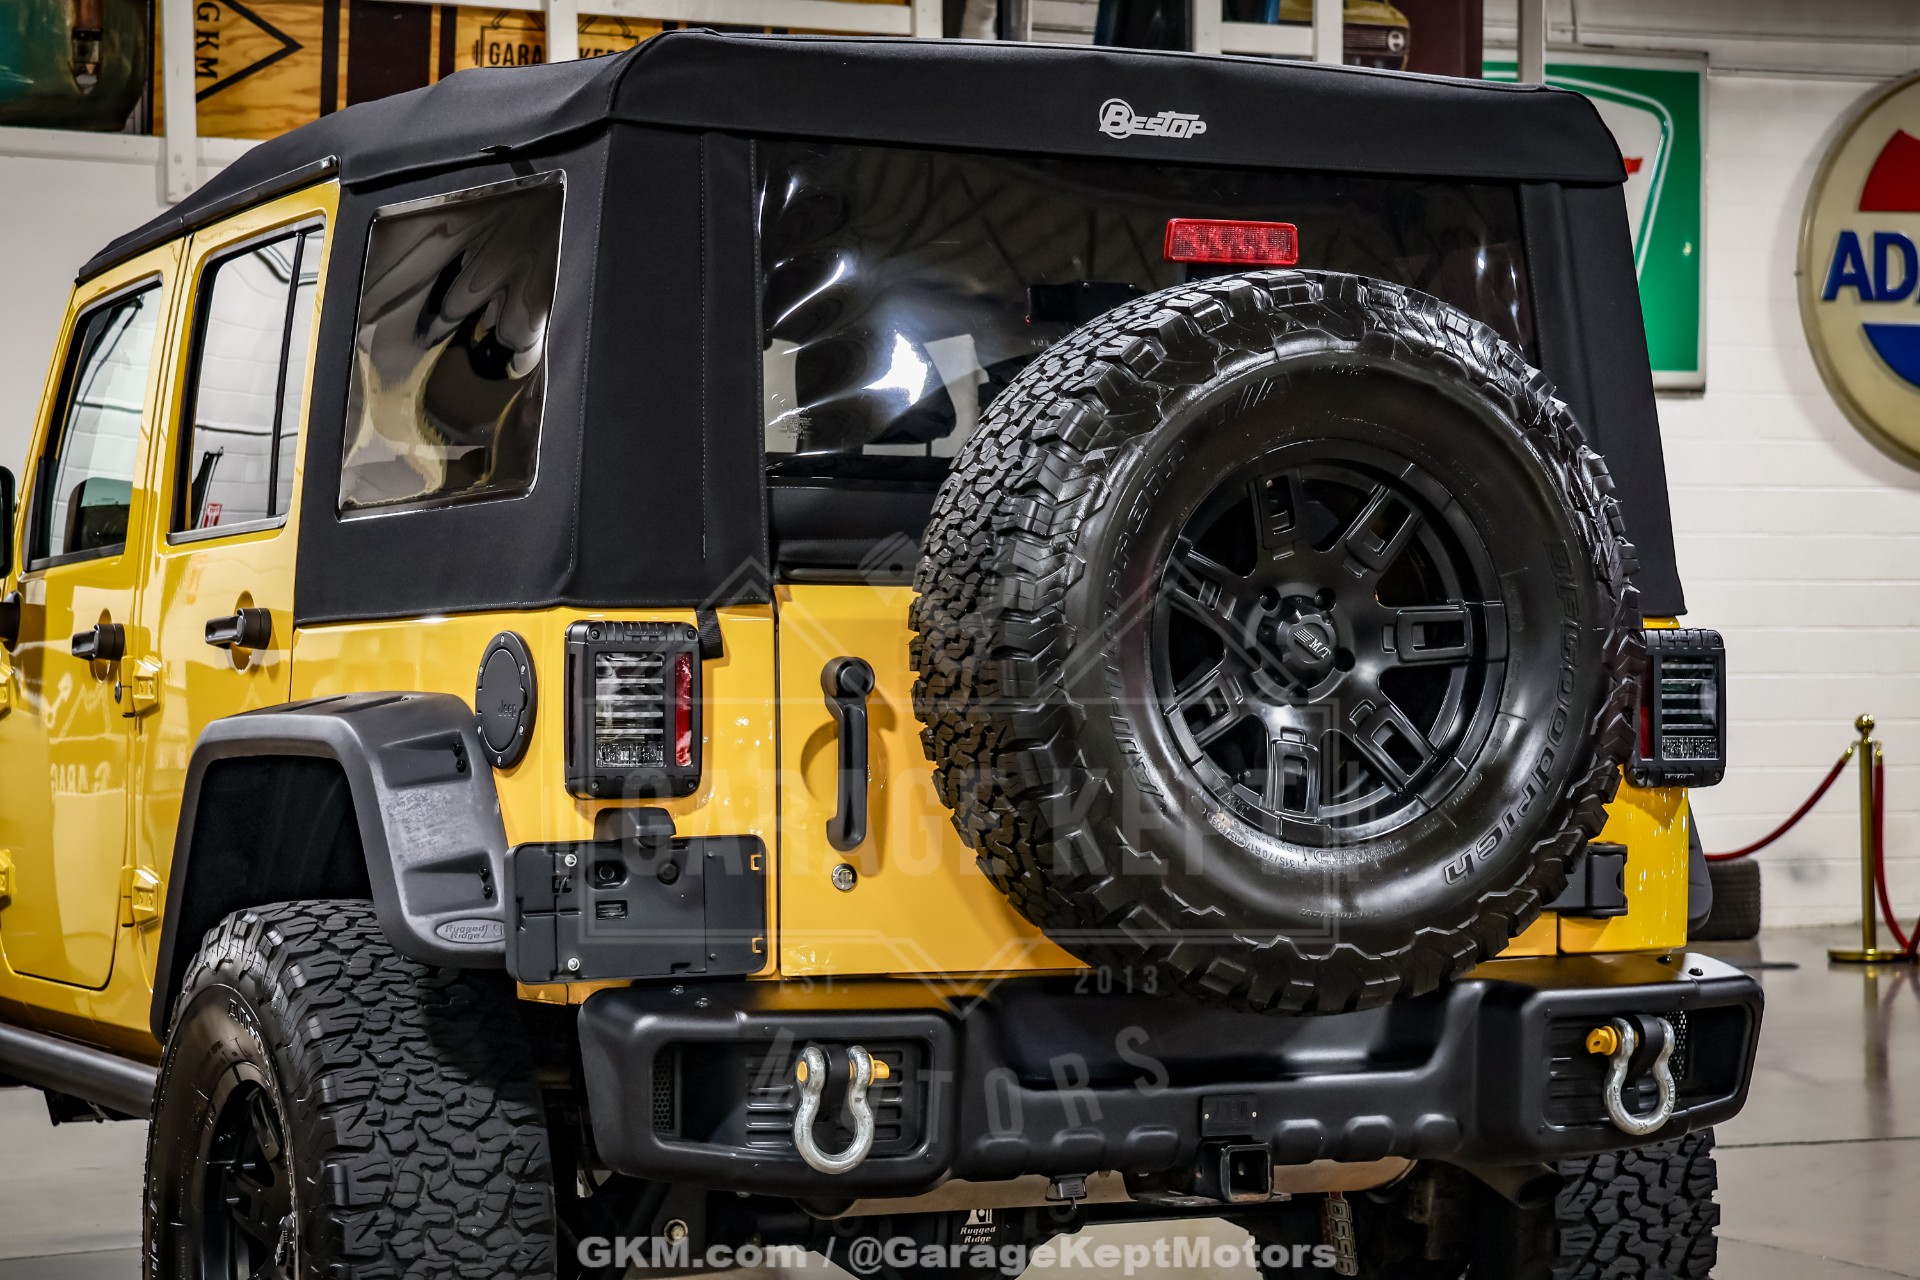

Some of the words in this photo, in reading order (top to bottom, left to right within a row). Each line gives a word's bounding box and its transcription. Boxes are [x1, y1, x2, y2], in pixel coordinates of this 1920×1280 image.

[195, 2, 221, 80] GKM
[489, 41, 543, 67] GARA
[1820, 230, 1920, 302] AD
[1308, 637, 1332, 659] M/T
[497, 699, 518, 719] Jeep
[1443, 539, 1581, 885] BFGoodrich
[445, 924, 486, 934] Rugged
[451, 932, 480, 941] Ridge
[960, 1226, 997, 1236] Rugged
[963, 1235, 992, 1245] Ridge
